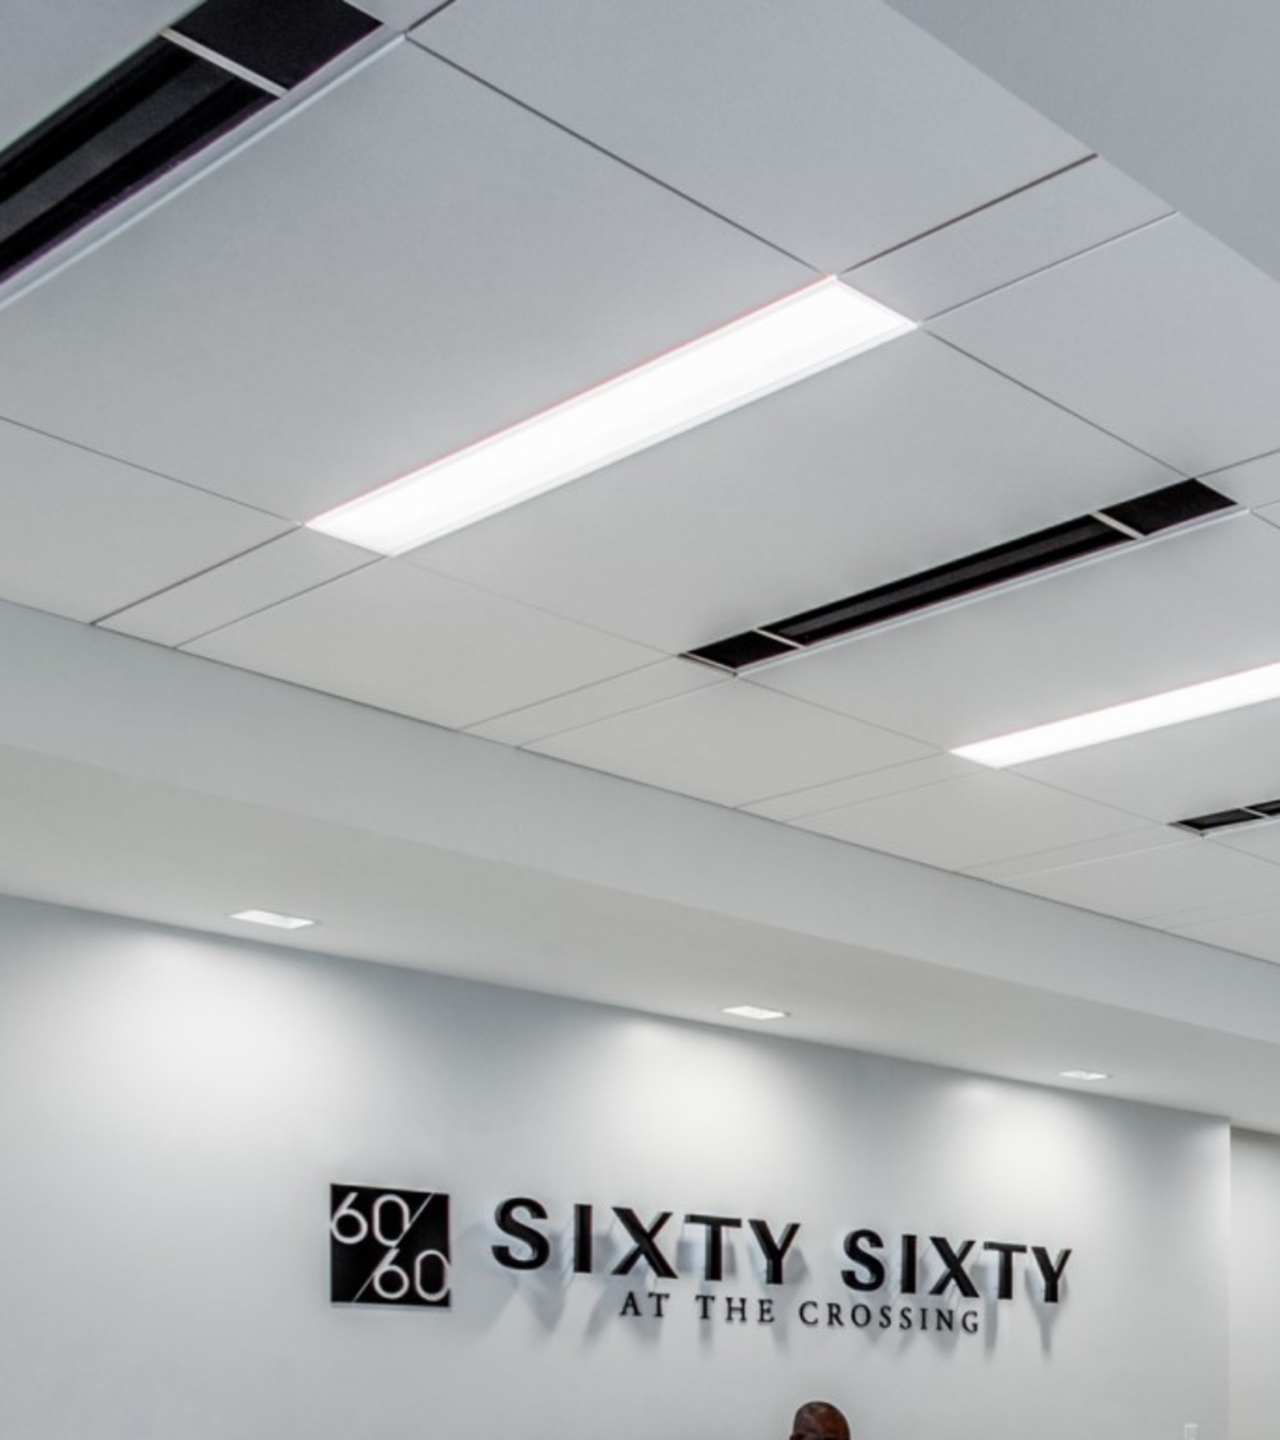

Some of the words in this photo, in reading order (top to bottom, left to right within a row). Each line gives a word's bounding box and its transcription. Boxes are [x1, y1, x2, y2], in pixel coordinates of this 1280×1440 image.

[491, 1197, 801, 1285] SIXTY
[841, 1229, 1073, 1303] SIXTY
[619, 1291, 670, 1318] AT
[695, 1294, 776, 1324] THE
[799, 1301, 980, 1335] CROSSING
